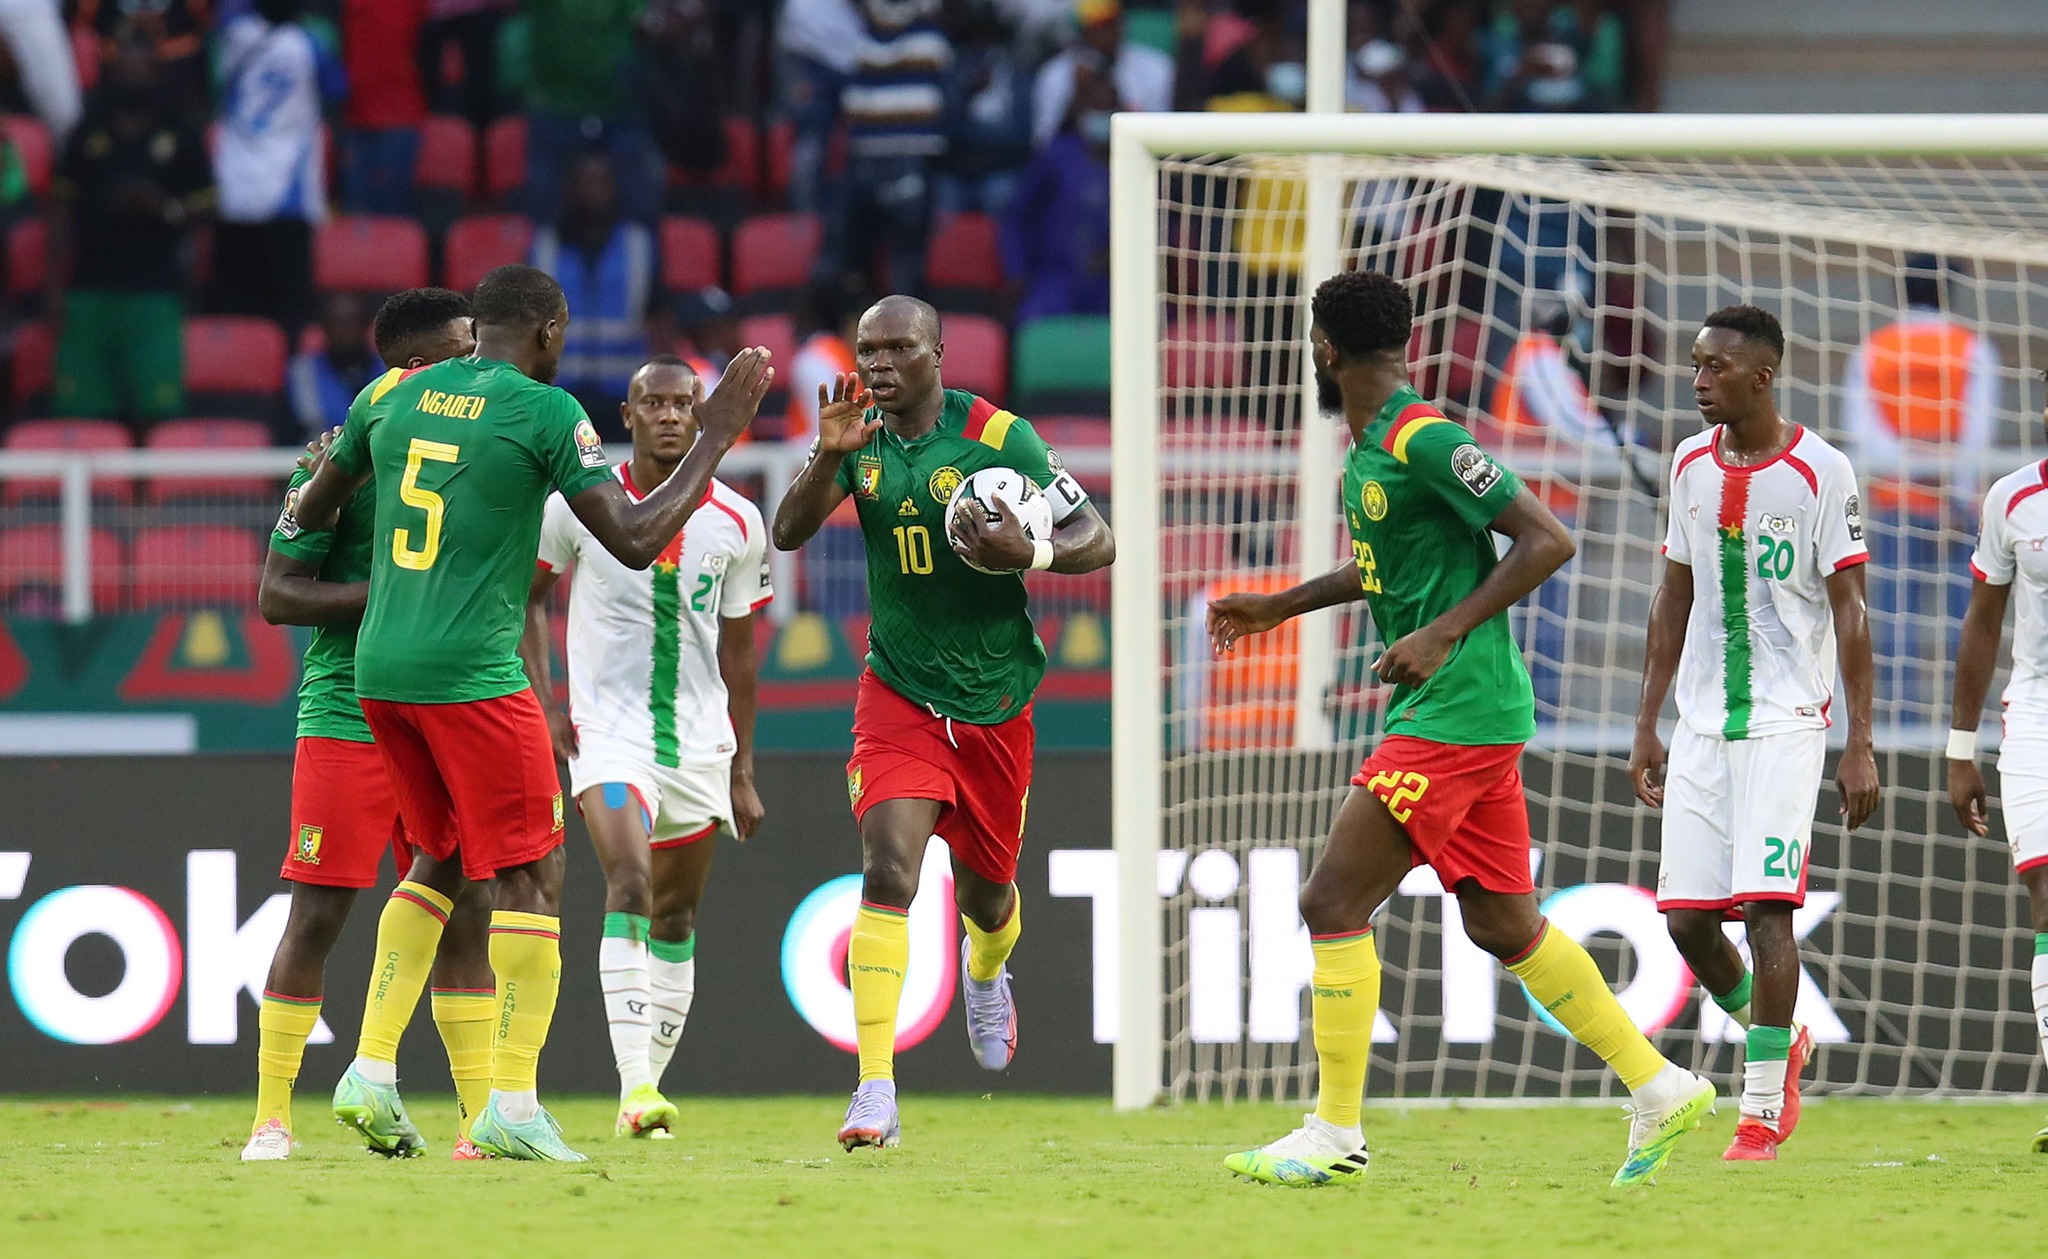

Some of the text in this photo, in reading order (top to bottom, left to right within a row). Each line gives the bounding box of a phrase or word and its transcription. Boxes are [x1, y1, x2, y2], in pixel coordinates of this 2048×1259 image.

[416, 389, 485, 420] NGADEU
[392, 437, 460, 571] 5
[1055, 477, 1080, 506] C
[893, 525, 933, 574] 10
[1757, 535, 1794, 581] 20
[1764, 836, 1801, 880] 20
[0, 849, 336, 1045] ok
[498, 982, 516, 1039] CAMERO
[1658, 1101, 1694, 1130] NEMESIS
